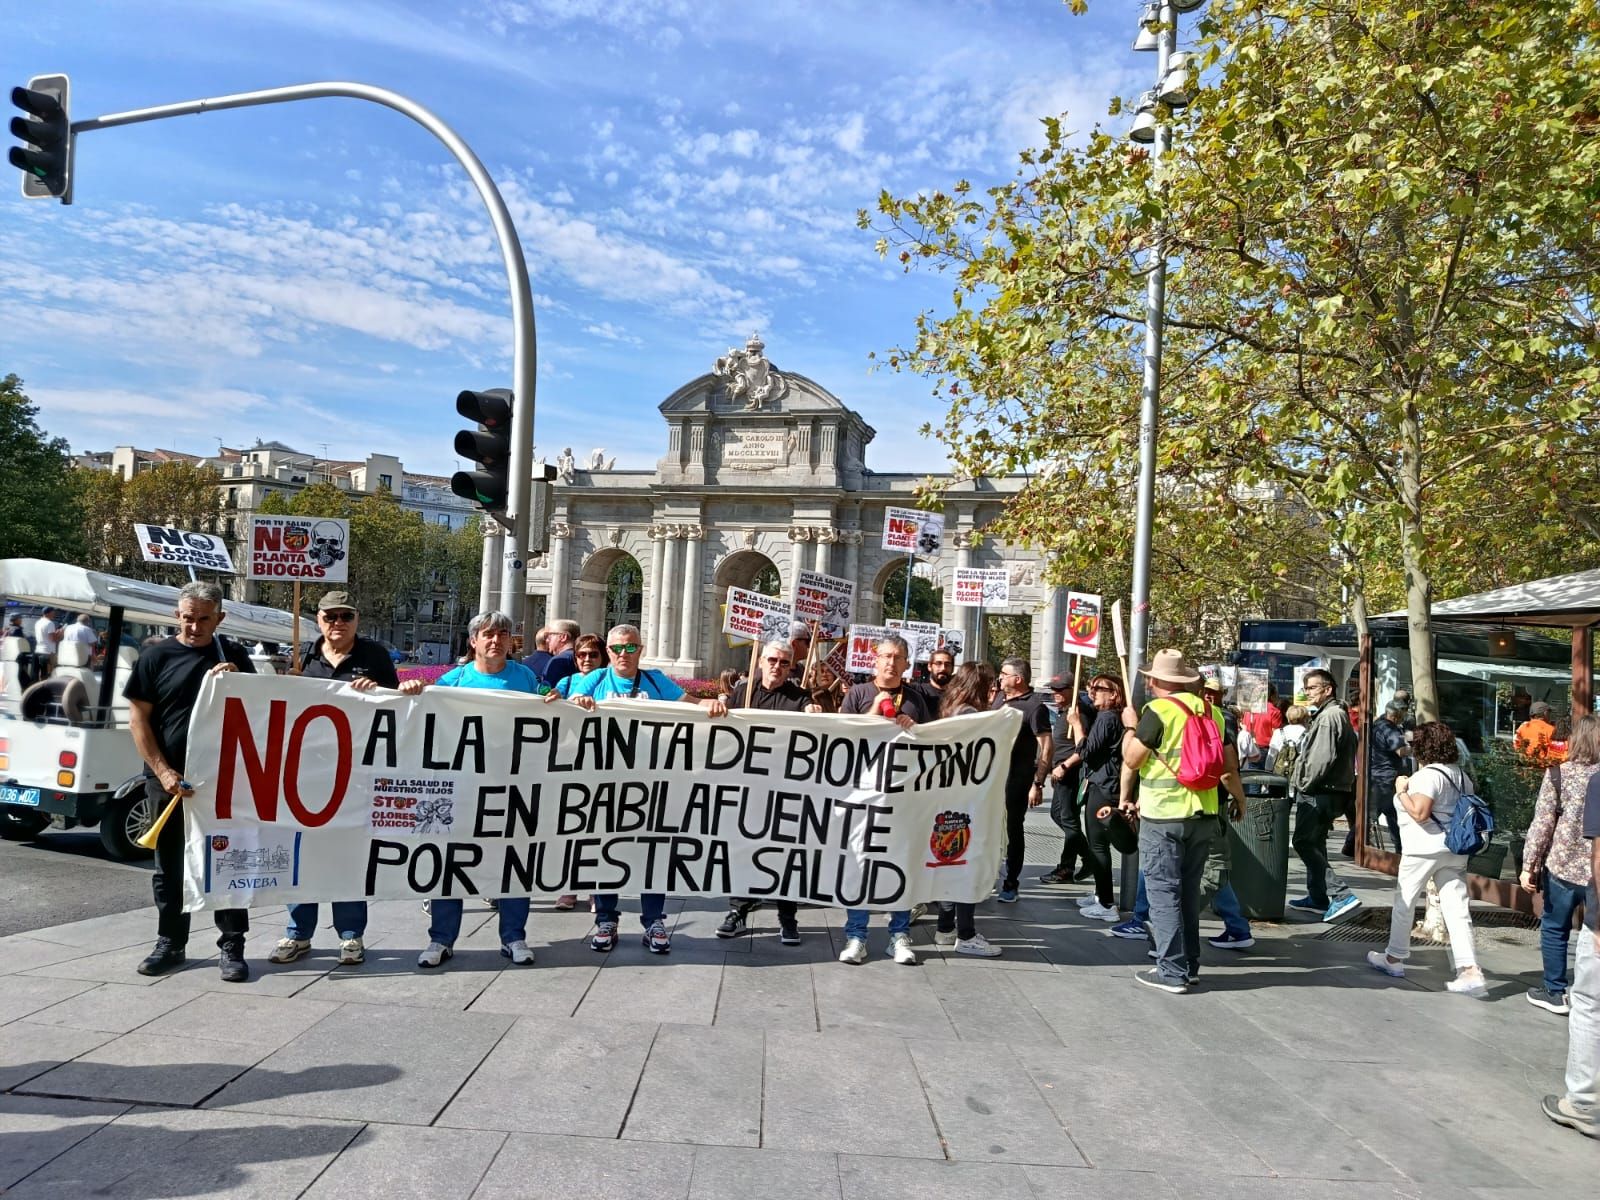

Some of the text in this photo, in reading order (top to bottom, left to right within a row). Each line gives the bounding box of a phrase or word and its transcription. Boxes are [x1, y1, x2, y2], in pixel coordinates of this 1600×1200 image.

[146, 526, 215, 551] NO
[254, 526, 310, 552] NO
[253, 552, 306, 563] PLANTA
[253, 562, 326, 578] BIOGAS
[825, 578, 844, 587] SALUD
[798, 586, 828, 600] STOP
[733, 596, 769, 610] NUESTROS
[759, 598, 781, 606] SALUD
[732, 604, 764, 618] STOP
[730, 616, 762, 627] OLORES
[215, 696, 353, 828] NO
[361, 708, 398, 768] A
[422, 712, 486, 774] LA
[510, 716, 695, 775] PLANTA
[704, 724, 776, 777] DE
[374, 778, 394, 786] POR
[373, 786, 424, 794] NUESTROS
[373, 795, 417, 809] STOP
[372, 811, 417, 821] OLORES
[473, 781, 894, 853] EN BABILAFUENTE
[364, 836, 907, 905] POR NUESTRA SALUD
[227, 877, 278, 890] ASVEBA
